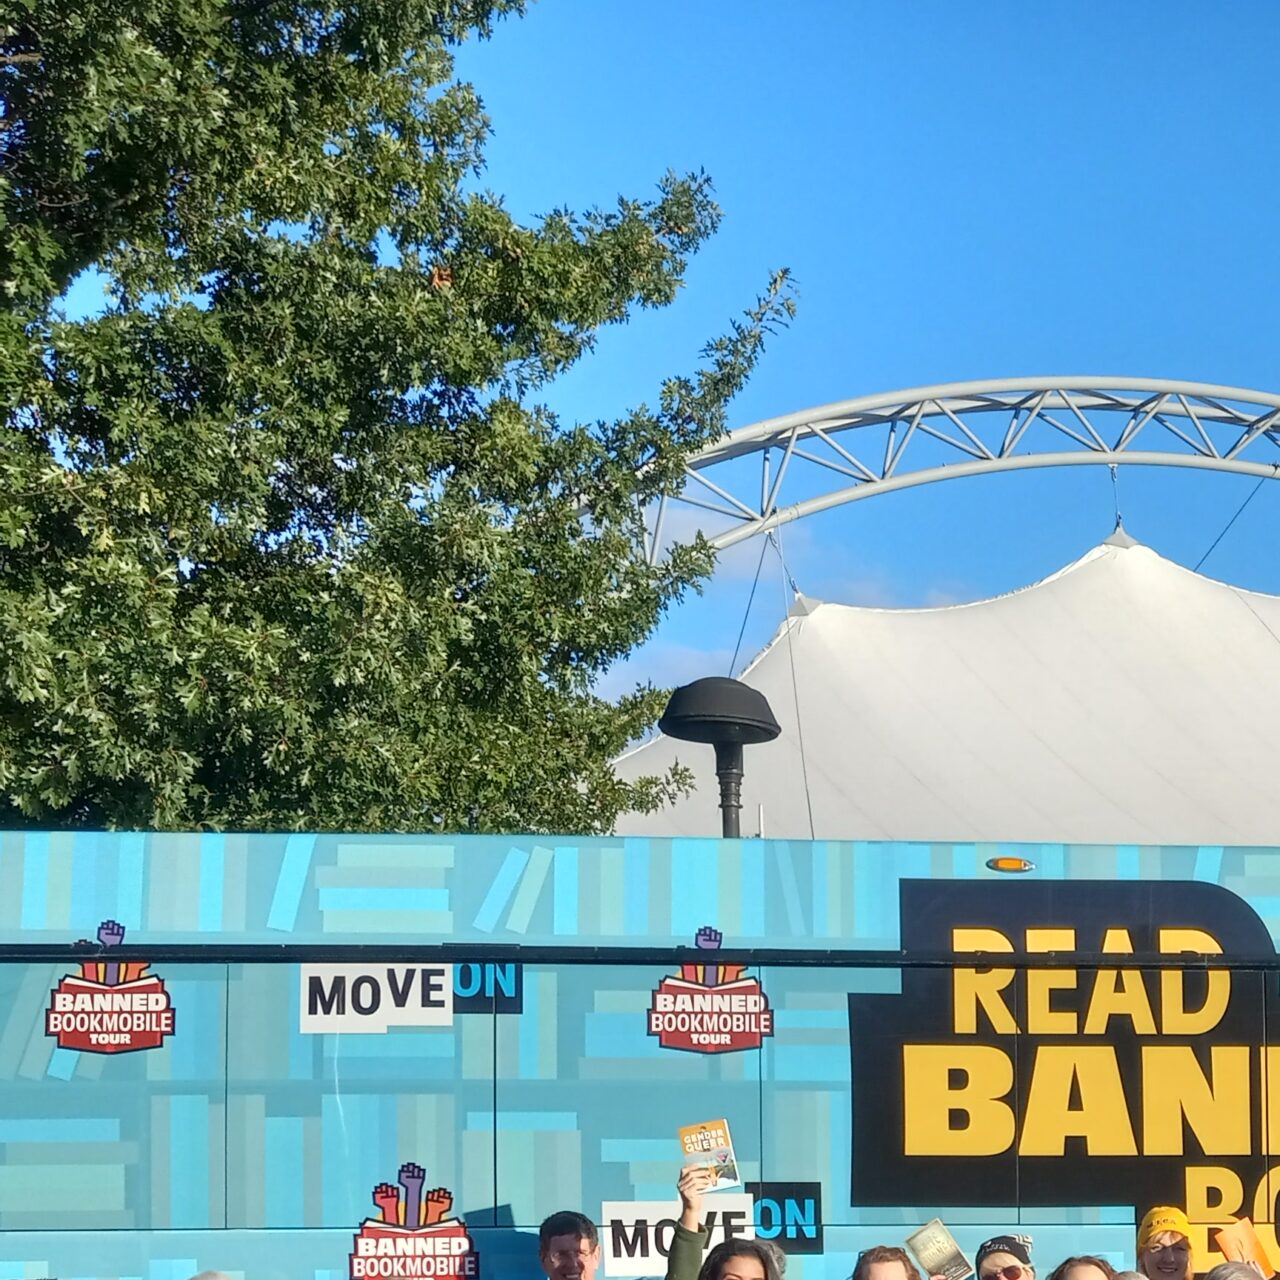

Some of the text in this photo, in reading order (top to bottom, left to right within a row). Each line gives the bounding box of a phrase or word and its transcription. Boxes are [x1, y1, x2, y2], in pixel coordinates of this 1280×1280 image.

[308, 963, 517, 1016] MOVE ON
[951, 928, 1232, 1035] READ
[55, 992, 167, 1012] BANNED
[656, 993, 765, 1012] BANNED
[49, 1013, 172, 1033] BOOKMOBILE
[651, 1013, 770, 1033] BOOKMOBILE
[90, 1033, 131, 1045] TOUR
[690, 1033, 731, 1045] TOUR
[684, 1129, 725, 1144] GENDER
[685, 1138, 725, 1152] QUEER
[754, 1198, 817, 1239] ON
[358, 1237, 470, 1256] BANNED
[353, 1256, 476, 1277] BOOKMOBILE
